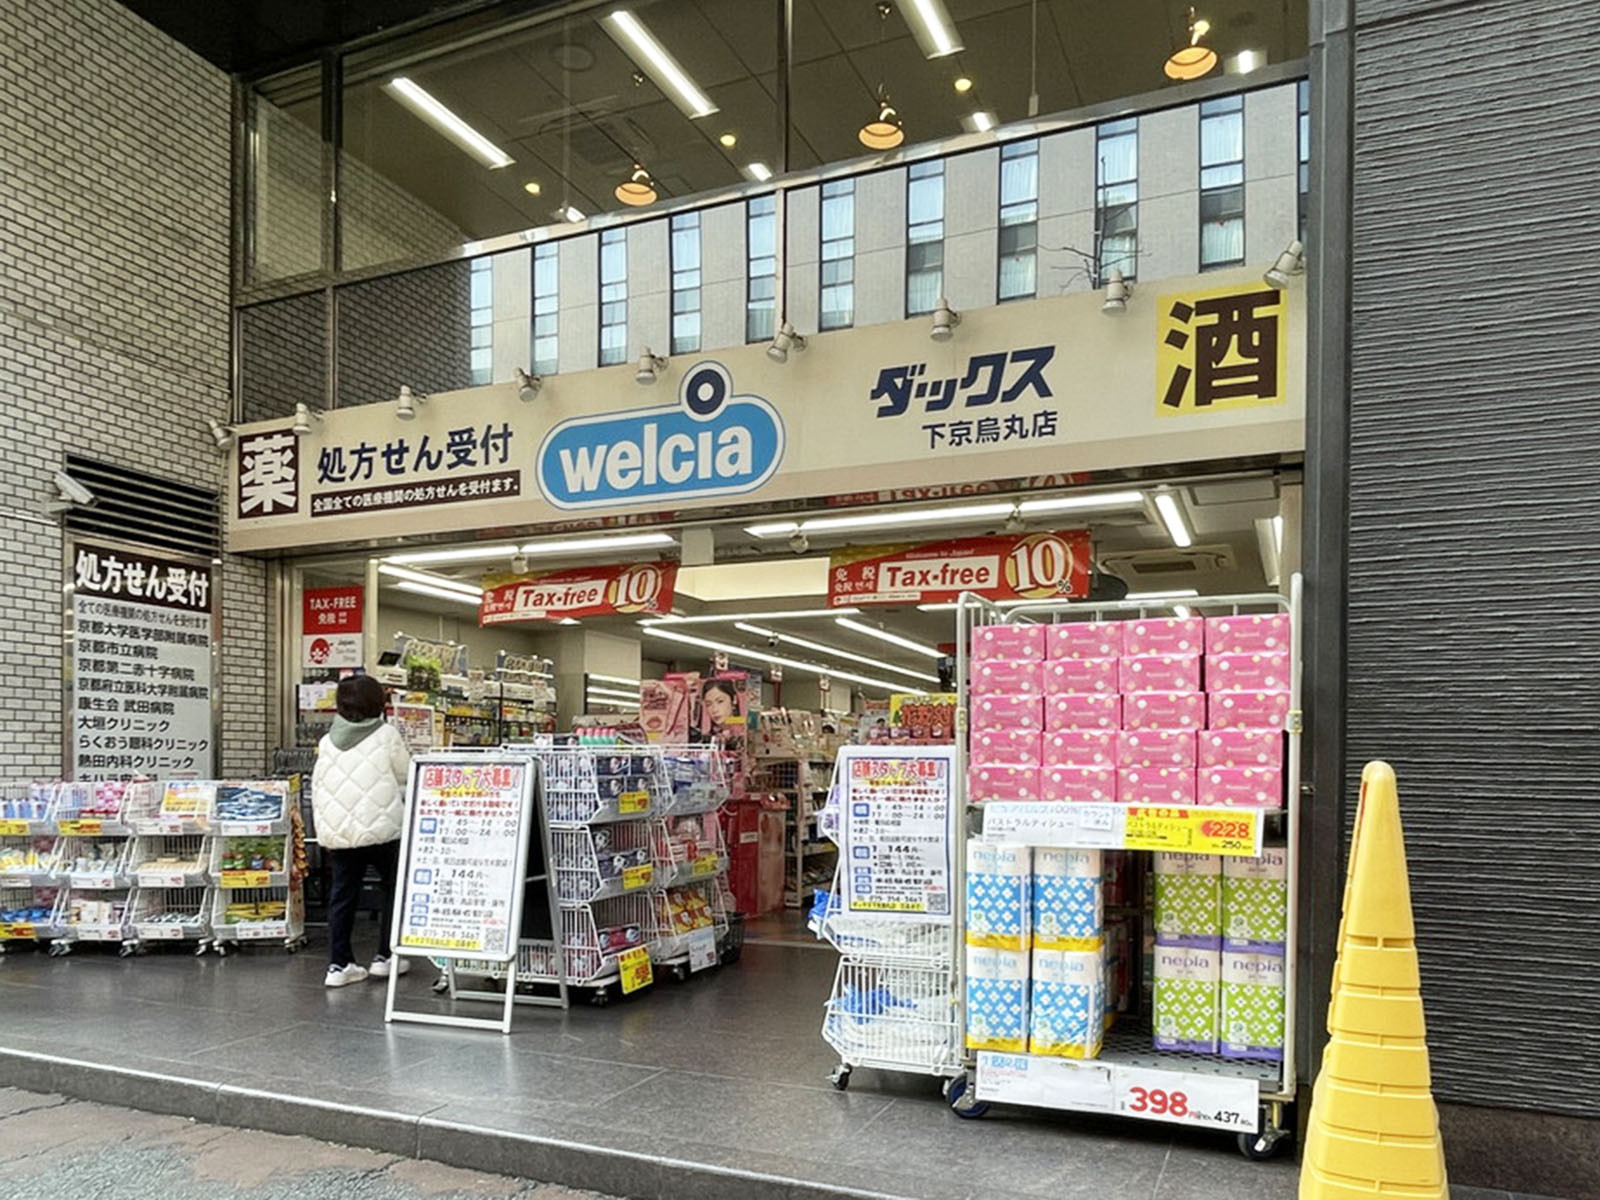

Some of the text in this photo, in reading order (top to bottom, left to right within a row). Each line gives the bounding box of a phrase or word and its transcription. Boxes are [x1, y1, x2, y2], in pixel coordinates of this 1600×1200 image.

[1163, 290, 1281, 409] 酒
[870, 345, 1056, 418] ダックス
[558, 382, 753, 494] welcia
[922, 410, 1058, 449] 下京烏丸店
[317, 423, 513, 484] 処方せん受付
[241, 434, 298, 514] 薬
[313, 476, 519, 514] 全国全ての医療機関の処方せんを受付ます。
[75, 549, 209, 608] 処方せん受付
[886, 563, 990, 589] Tax-free
[309, 596, 357, 611] TAX-FREE
[521, 586, 598, 608] Tax-free
[77, 618, 209, 648] 京都大学医学部附属病院
[77, 638, 158, 660] 京都市立病院
[77, 658, 195, 681] 京都第二赤十字病院
[77, 677, 209, 701] 京都府立医科大学附属病院
[78, 696, 175, 716] 康生会 武田病院
[78, 715, 170, 733] 大垣クリニック
[78, 734, 209, 752] らくおう眼科クリニック
[1212, 821, 1250, 839] 228
[1221, 840, 1242, 850] 250
[1038, 954, 1085, 973] nepia
[1161, 954, 1210, 970] nepia
[1232, 959, 1284, 976] nepia
[1129, 1086, 1188, 1118] 398
[1214, 1111, 1240, 1124] 437
